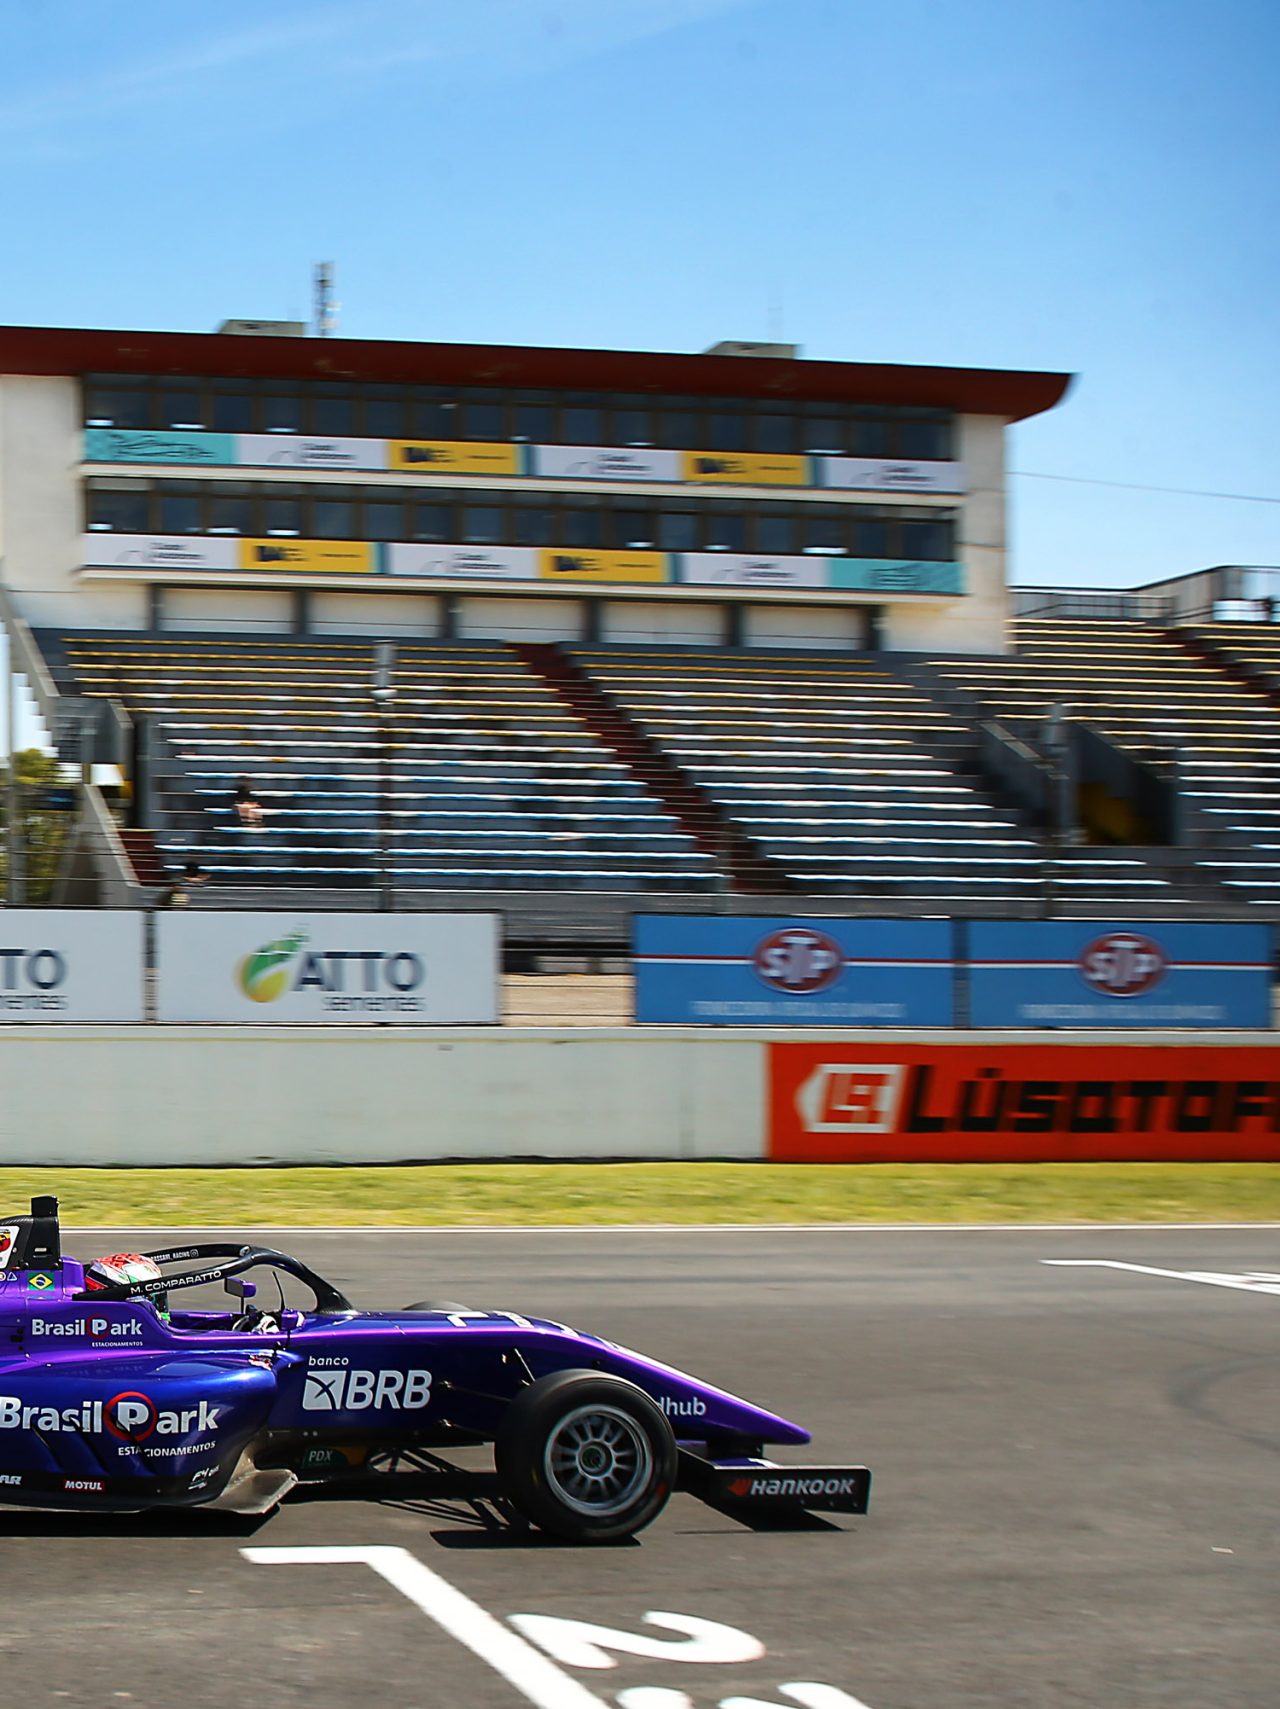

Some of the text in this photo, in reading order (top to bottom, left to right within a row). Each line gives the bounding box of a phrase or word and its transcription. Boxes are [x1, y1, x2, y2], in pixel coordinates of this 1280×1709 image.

[758, 935, 838, 984] STP
[1083, 940, 1164, 988] STP
[288, 950, 428, 992] ATTO
[144, 1270, 222, 1292] COMPARATTO
[31, 1318, 143, 1336] Brasil Park
[91, 1340, 144, 1348] ESTACIONAMENTOS
[308, 1355, 350, 1367] banco
[345, 1369, 433, 1410] BRB
[115, 1400, 222, 1435] Park
[308, 1450, 333, 1463] PDX
[64, 1480, 103, 1491] MOTUL
